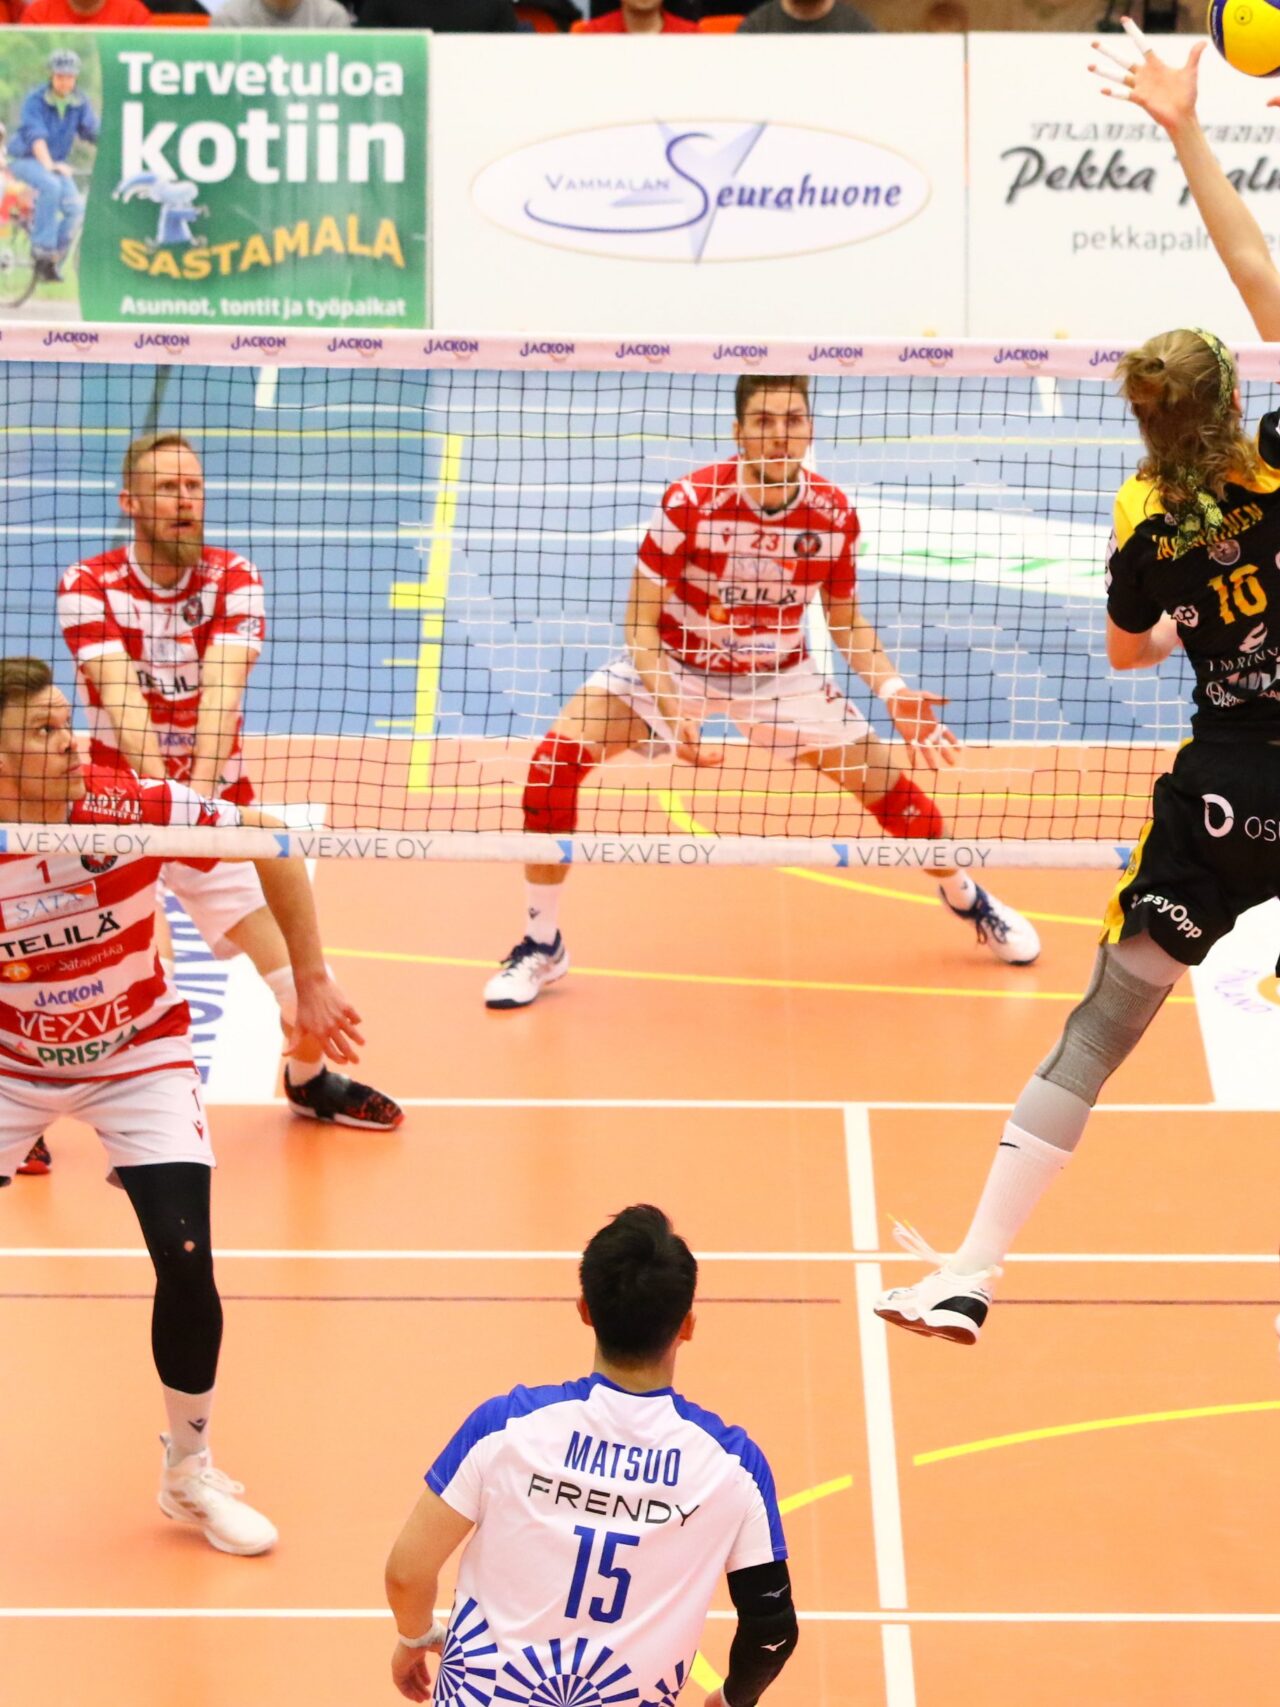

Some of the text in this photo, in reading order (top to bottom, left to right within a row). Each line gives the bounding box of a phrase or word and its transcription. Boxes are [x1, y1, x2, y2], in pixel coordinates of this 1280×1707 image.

[118, 51, 404, 96] Tervetuloa
[121, 102, 405, 183] kotiin
[1000, 146, 1157, 205] Pekka
[119, 213, 406, 281] SASTAMALA
[121, 297, 407, 319] Asunnot, tontit ja työpaikat
[42, 333, 99, 349] JACKON
[134, 335, 190, 350] JACKON
[231, 336, 286, 351] JACKON
[330, 339, 383, 354] JACKON
[426, 340, 479, 355] JACKON
[522, 343, 575, 358] JACKON
[616, 344, 670, 359] JACKON
[714, 345, 768, 360] JACKON
[810, 347, 863, 362] JACKON
[899, 347, 954, 362] JACKON
[994, 349, 1049, 364] JACKON
[751, 531, 780, 551] 23
[1207, 563, 1268, 625] 10
[16, 833, 152, 854] VEXVE OY
[297, 838, 434, 859] VEXVE OY
[580, 842, 717, 864] VEXVE OY
[855, 846, 992, 868] VEXVE OY
[36, 860, 52, 885] 1
[0, 911, 121, 958] TELILÄ
[34, 980, 104, 1008] JACKON
[16, 995, 132, 1043] VEXVE
[564, 1431, 682, 1487] MATSUO
[528, 1474, 700, 1527] FRENDY
[564, 1525, 641, 1625] 15
